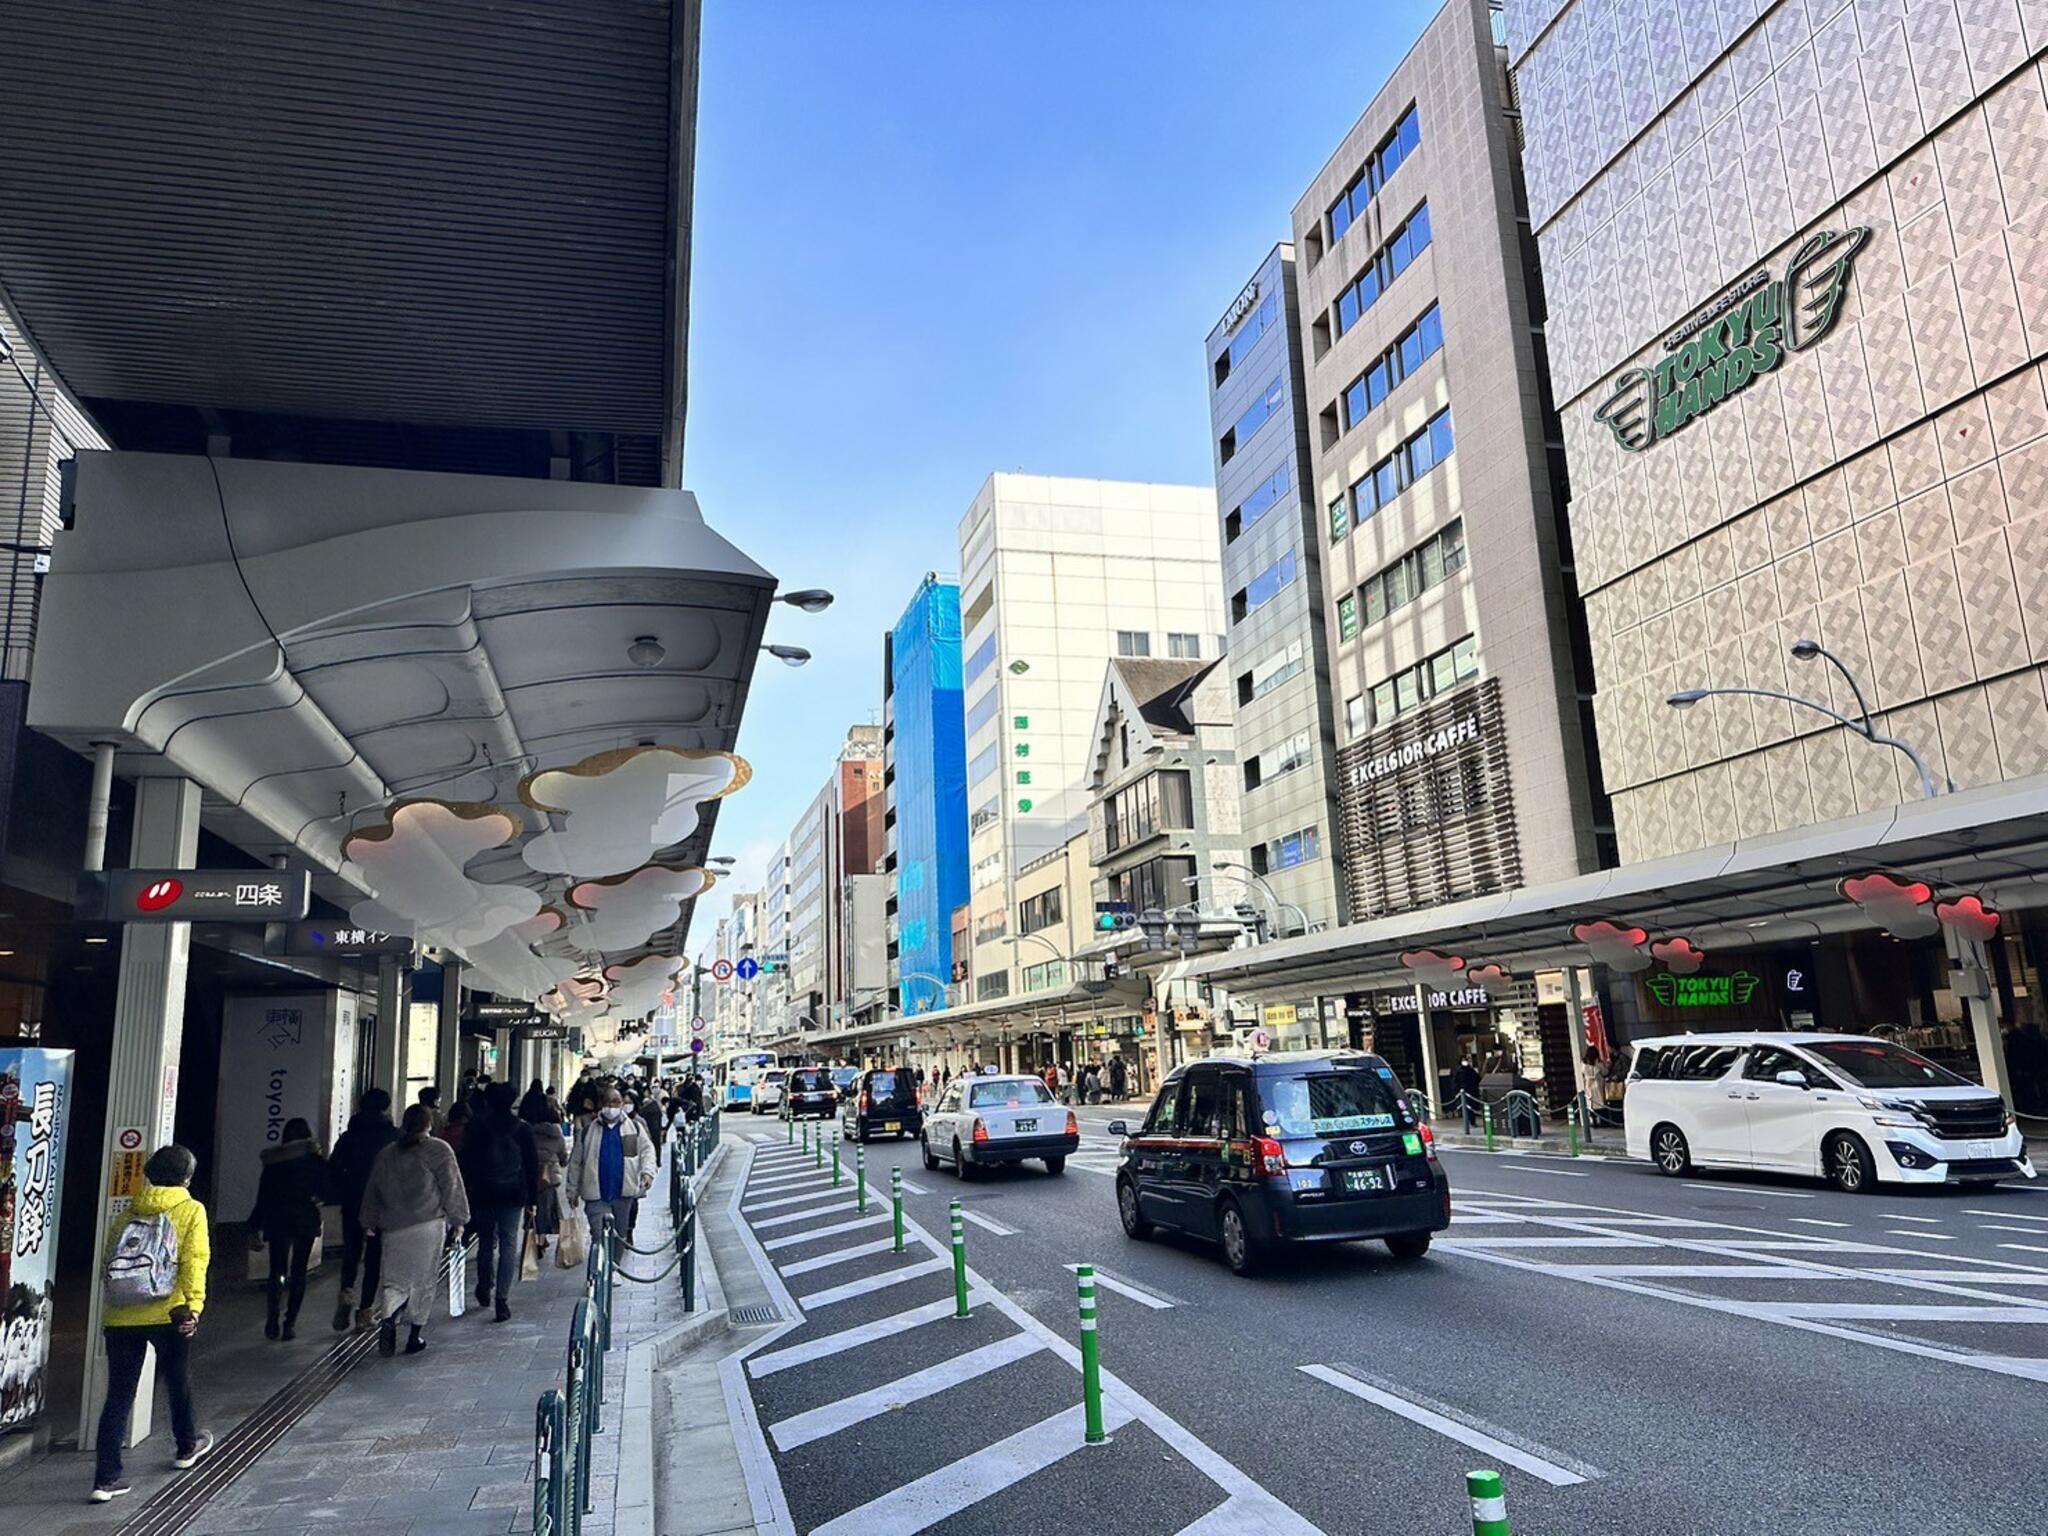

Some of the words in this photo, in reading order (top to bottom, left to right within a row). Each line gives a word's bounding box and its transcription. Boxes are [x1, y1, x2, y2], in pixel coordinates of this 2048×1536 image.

[1654, 280, 1782, 398] TOKYU
[1654, 327, 1783, 439] HANDS
[1349, 741, 1425, 787] EXCELSIOR
[1424, 713, 1479, 755] CAFFÉ
[235, 883, 283, 906] 四条
[334, 930, 392, 945] 東横イン
[1390, 992, 1448, 1011] EXCEIOR
[1449, 984, 1488, 1006] CAFFÉ
[1677, 977, 1730, 991] TOKYU
[1677, 991, 1730, 1006] HANDS
[264, 1068, 288, 1142] toyoko
[17, 1080, 55, 1257] 長刀鉾
